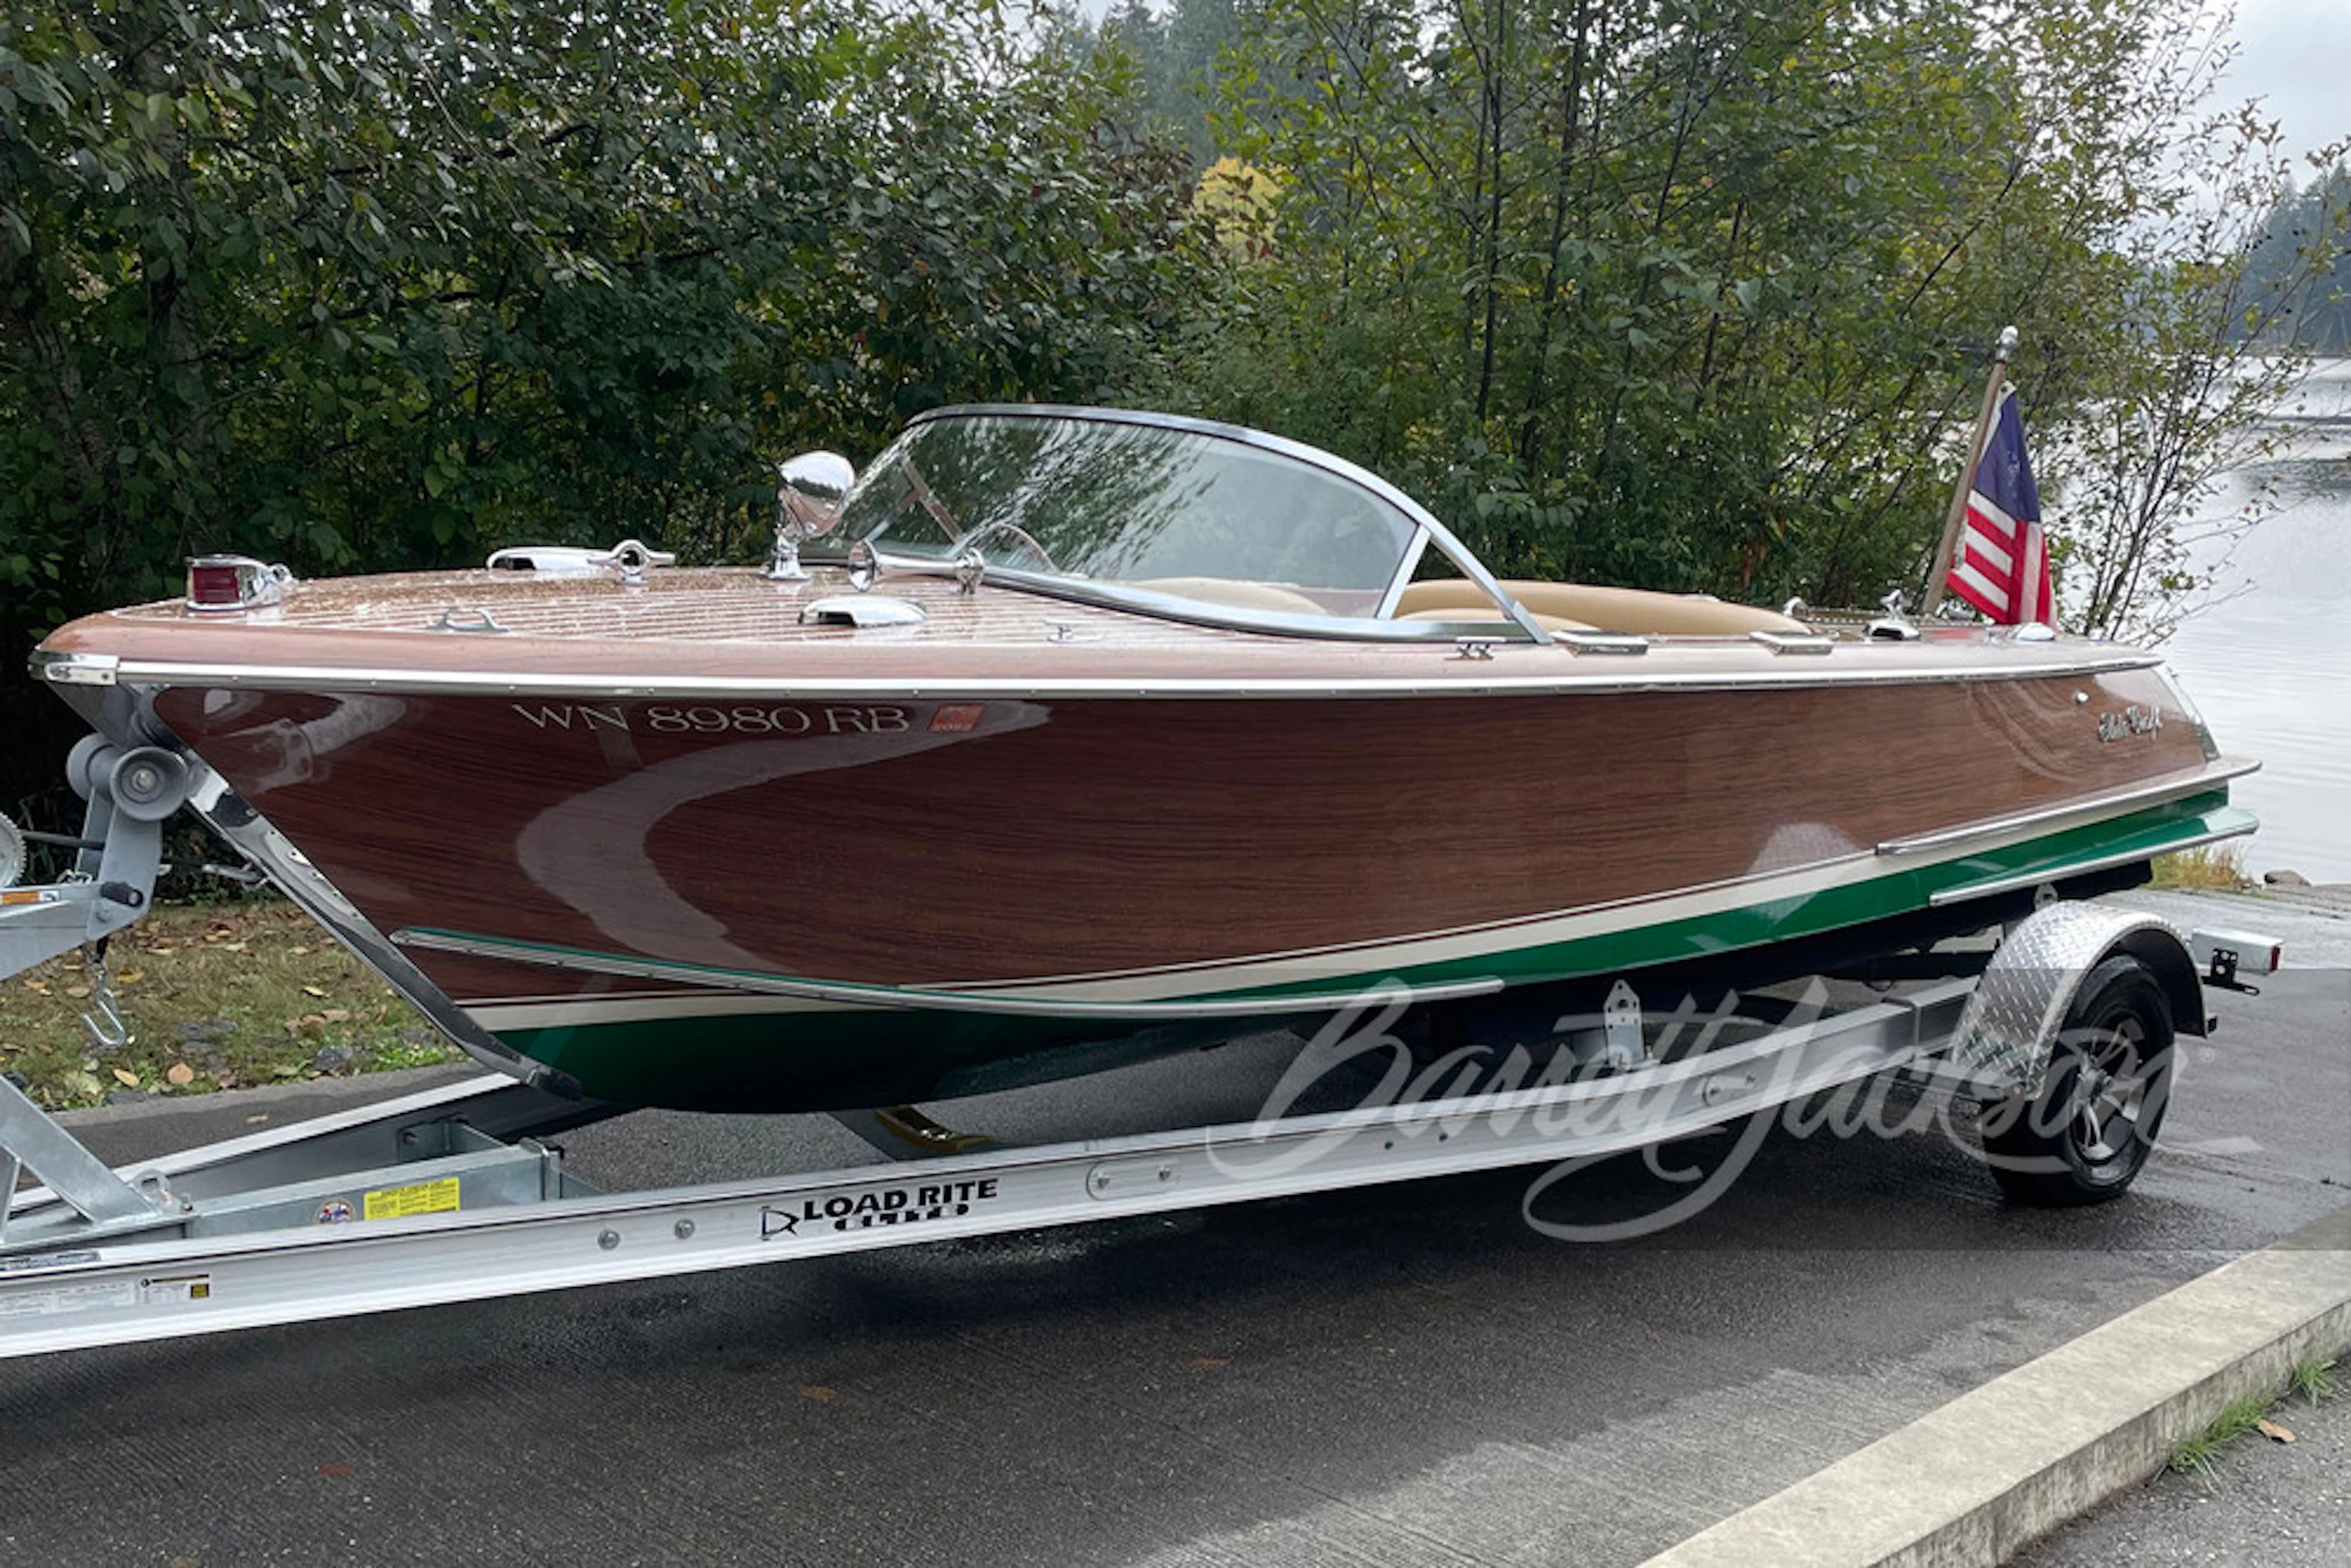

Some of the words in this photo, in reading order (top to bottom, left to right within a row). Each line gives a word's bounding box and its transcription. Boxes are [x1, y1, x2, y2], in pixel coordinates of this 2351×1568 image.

[511, 703, 631, 730] WN
[647, 705, 811, 733] 8980
[823, 707, 910, 733] RB
[803, 1190, 908, 1222] LOAD
[918, 1178, 999, 1207] RITE
